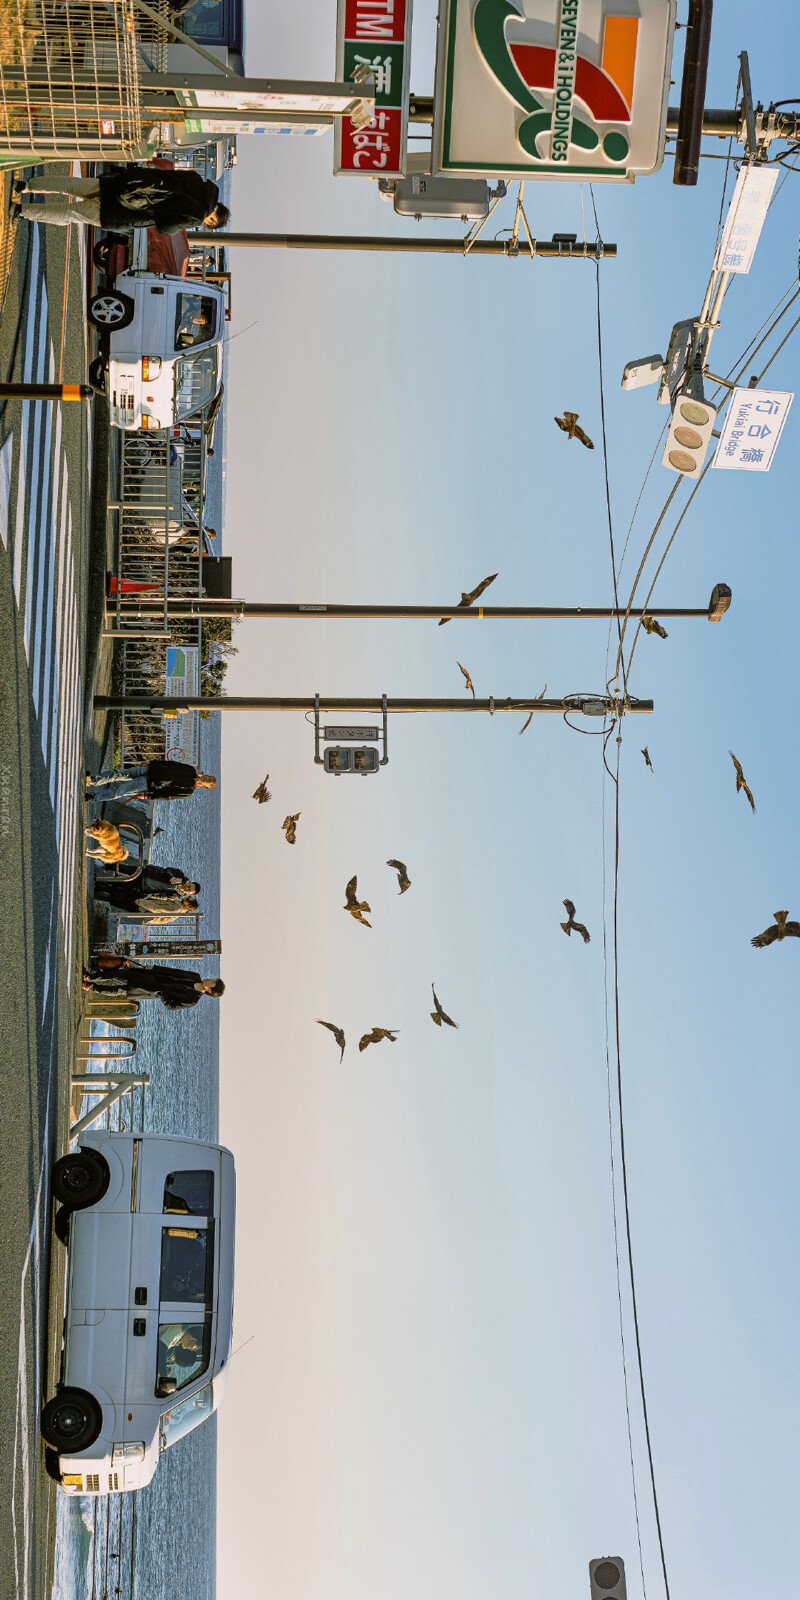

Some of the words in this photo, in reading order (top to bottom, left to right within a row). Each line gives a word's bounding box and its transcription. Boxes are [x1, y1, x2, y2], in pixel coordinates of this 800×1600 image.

[551, 76, 573, 162] HOLDINGS
[733, 403, 753, 428] Yukiai
[739, 399, 782, 463] 行合橋
[724, 430, 744, 457] Bridge
